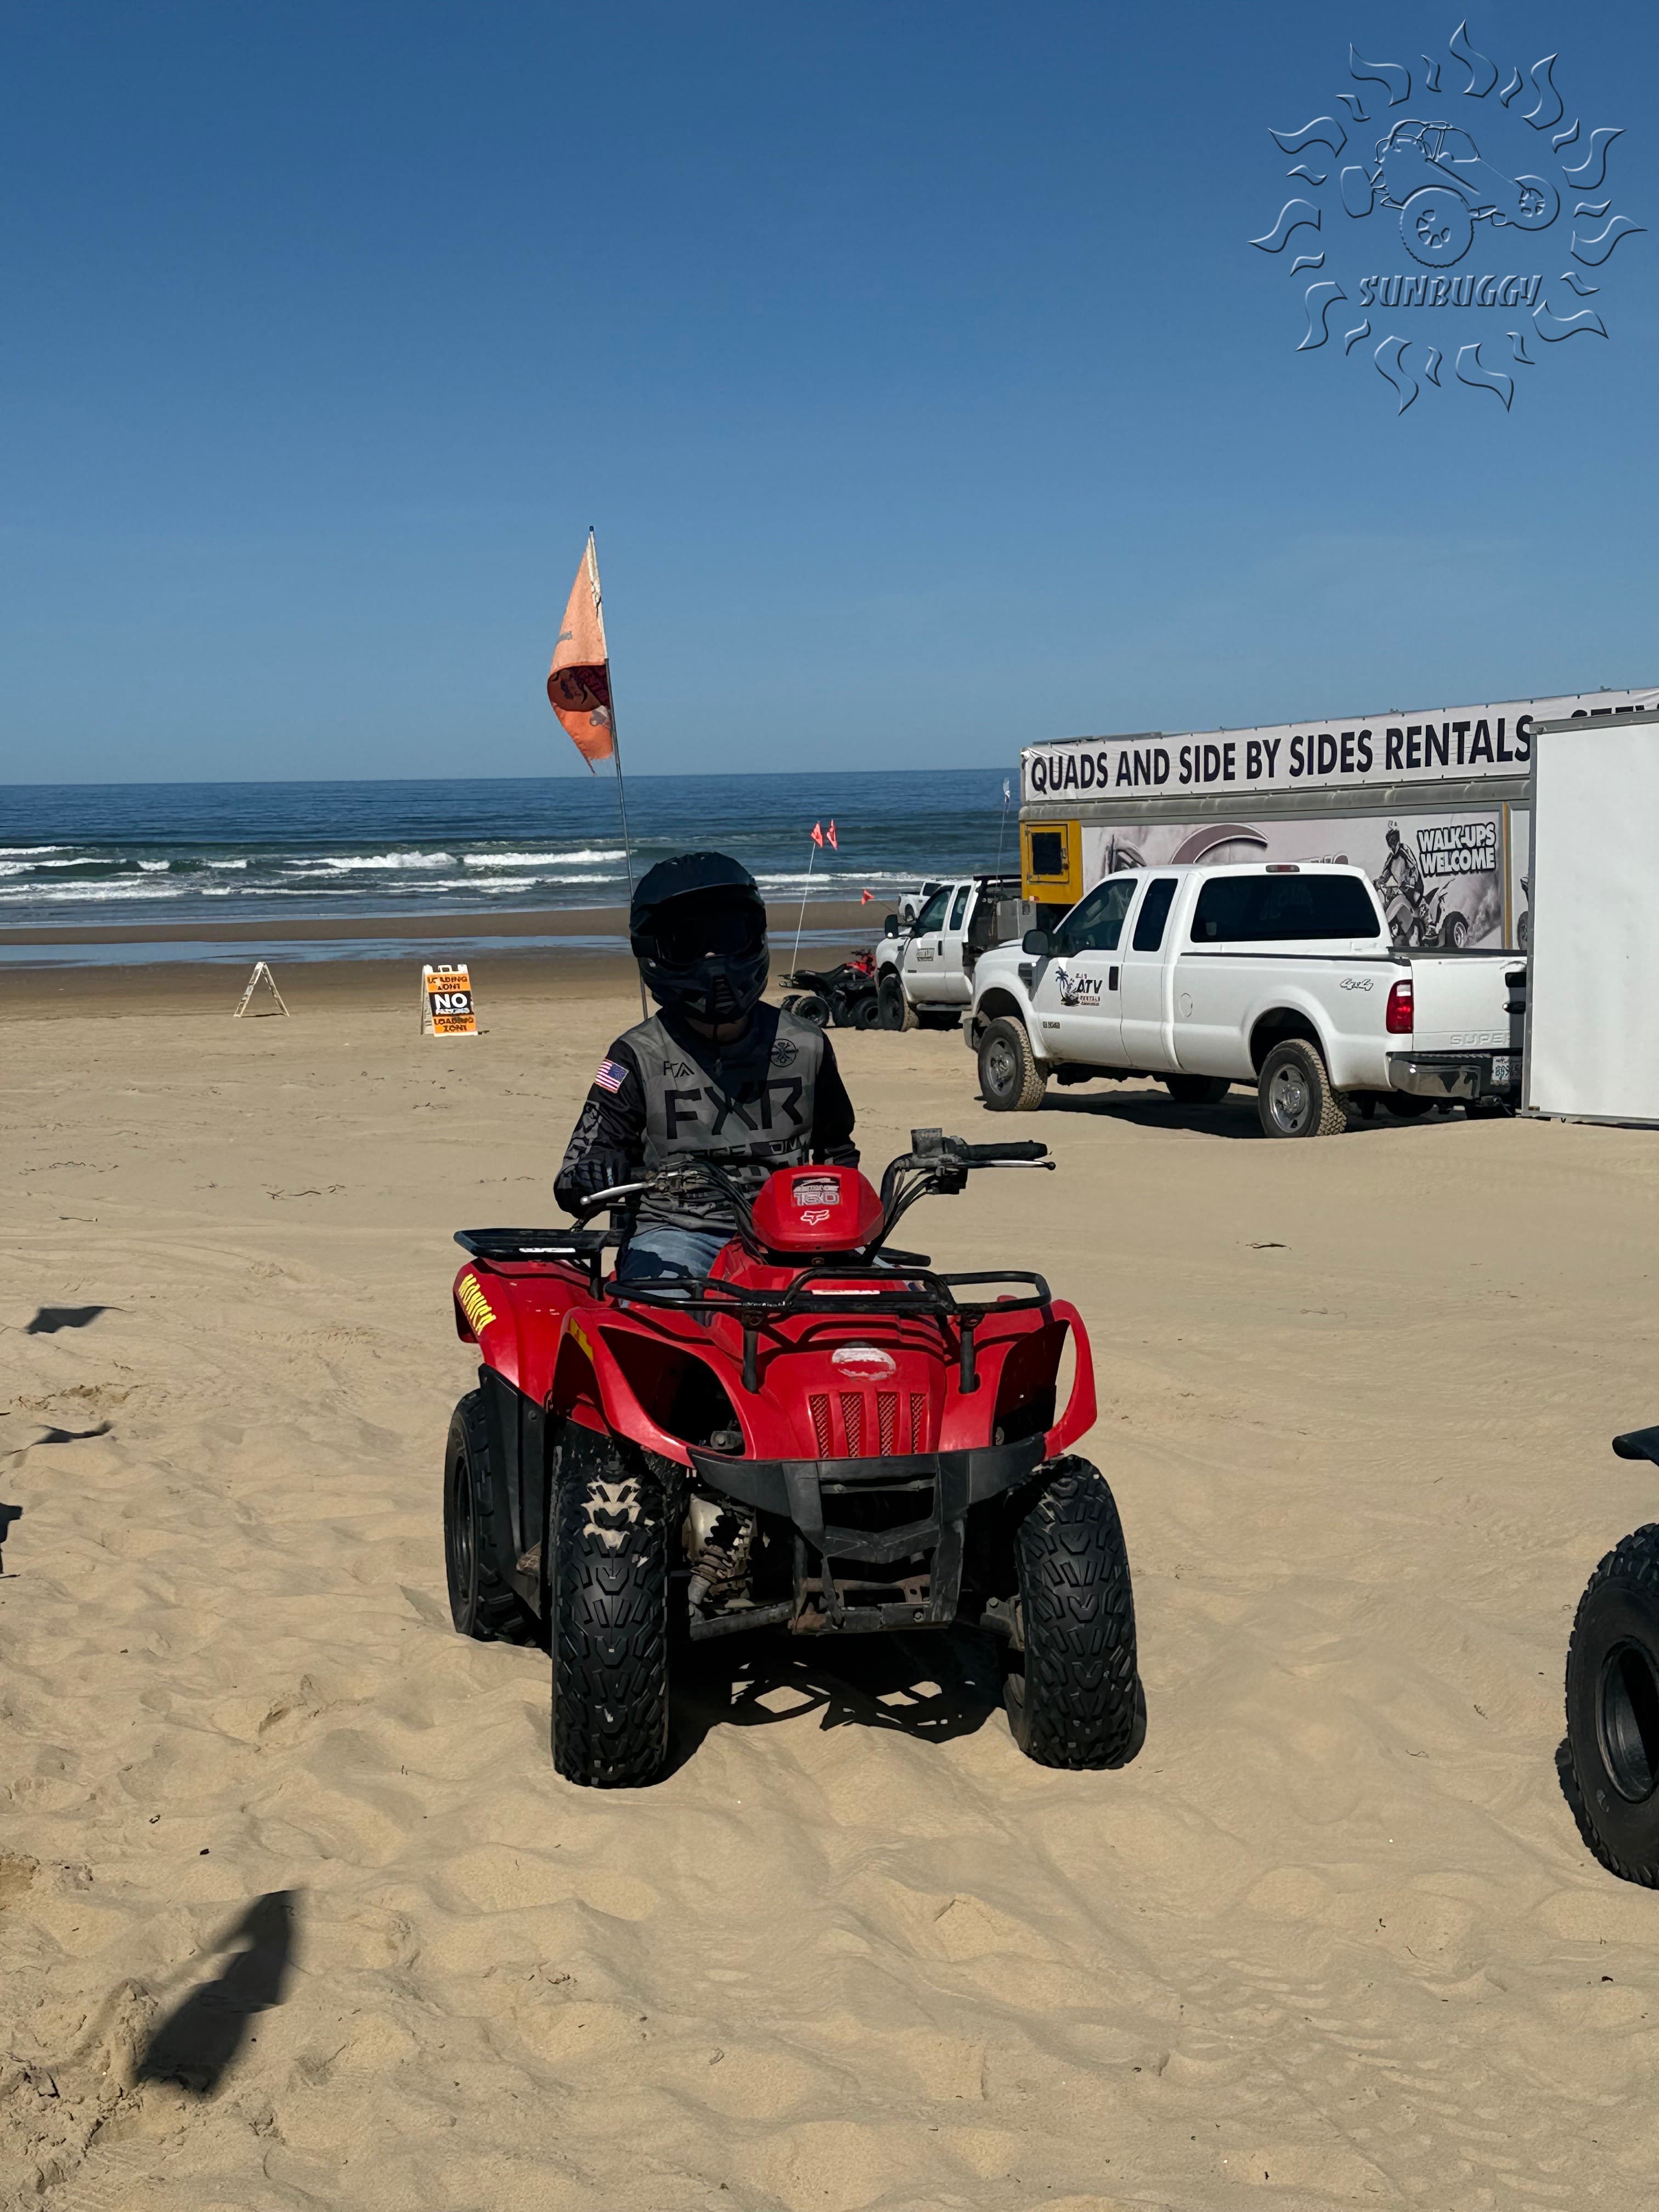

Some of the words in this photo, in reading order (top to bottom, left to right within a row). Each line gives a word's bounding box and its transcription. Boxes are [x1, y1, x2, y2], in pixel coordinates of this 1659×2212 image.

[1031, 752, 1108, 794] QUADS
[1115, 748, 1170, 787] AND
[1179, 742, 1235, 785] SIDE
[1246, 738, 1281, 780] BY
[1289, 729, 1373, 777] SIDES
[1386, 714, 1533, 770] RENTALS
[1418, 822, 1496, 852] WALK-UPS
[1420, 847, 1496, 875] WELCOME
[435, 992, 467, 1008] NO
[1076, 979, 1103, 994] ATV
[665, 1076, 803, 1139] FXR
